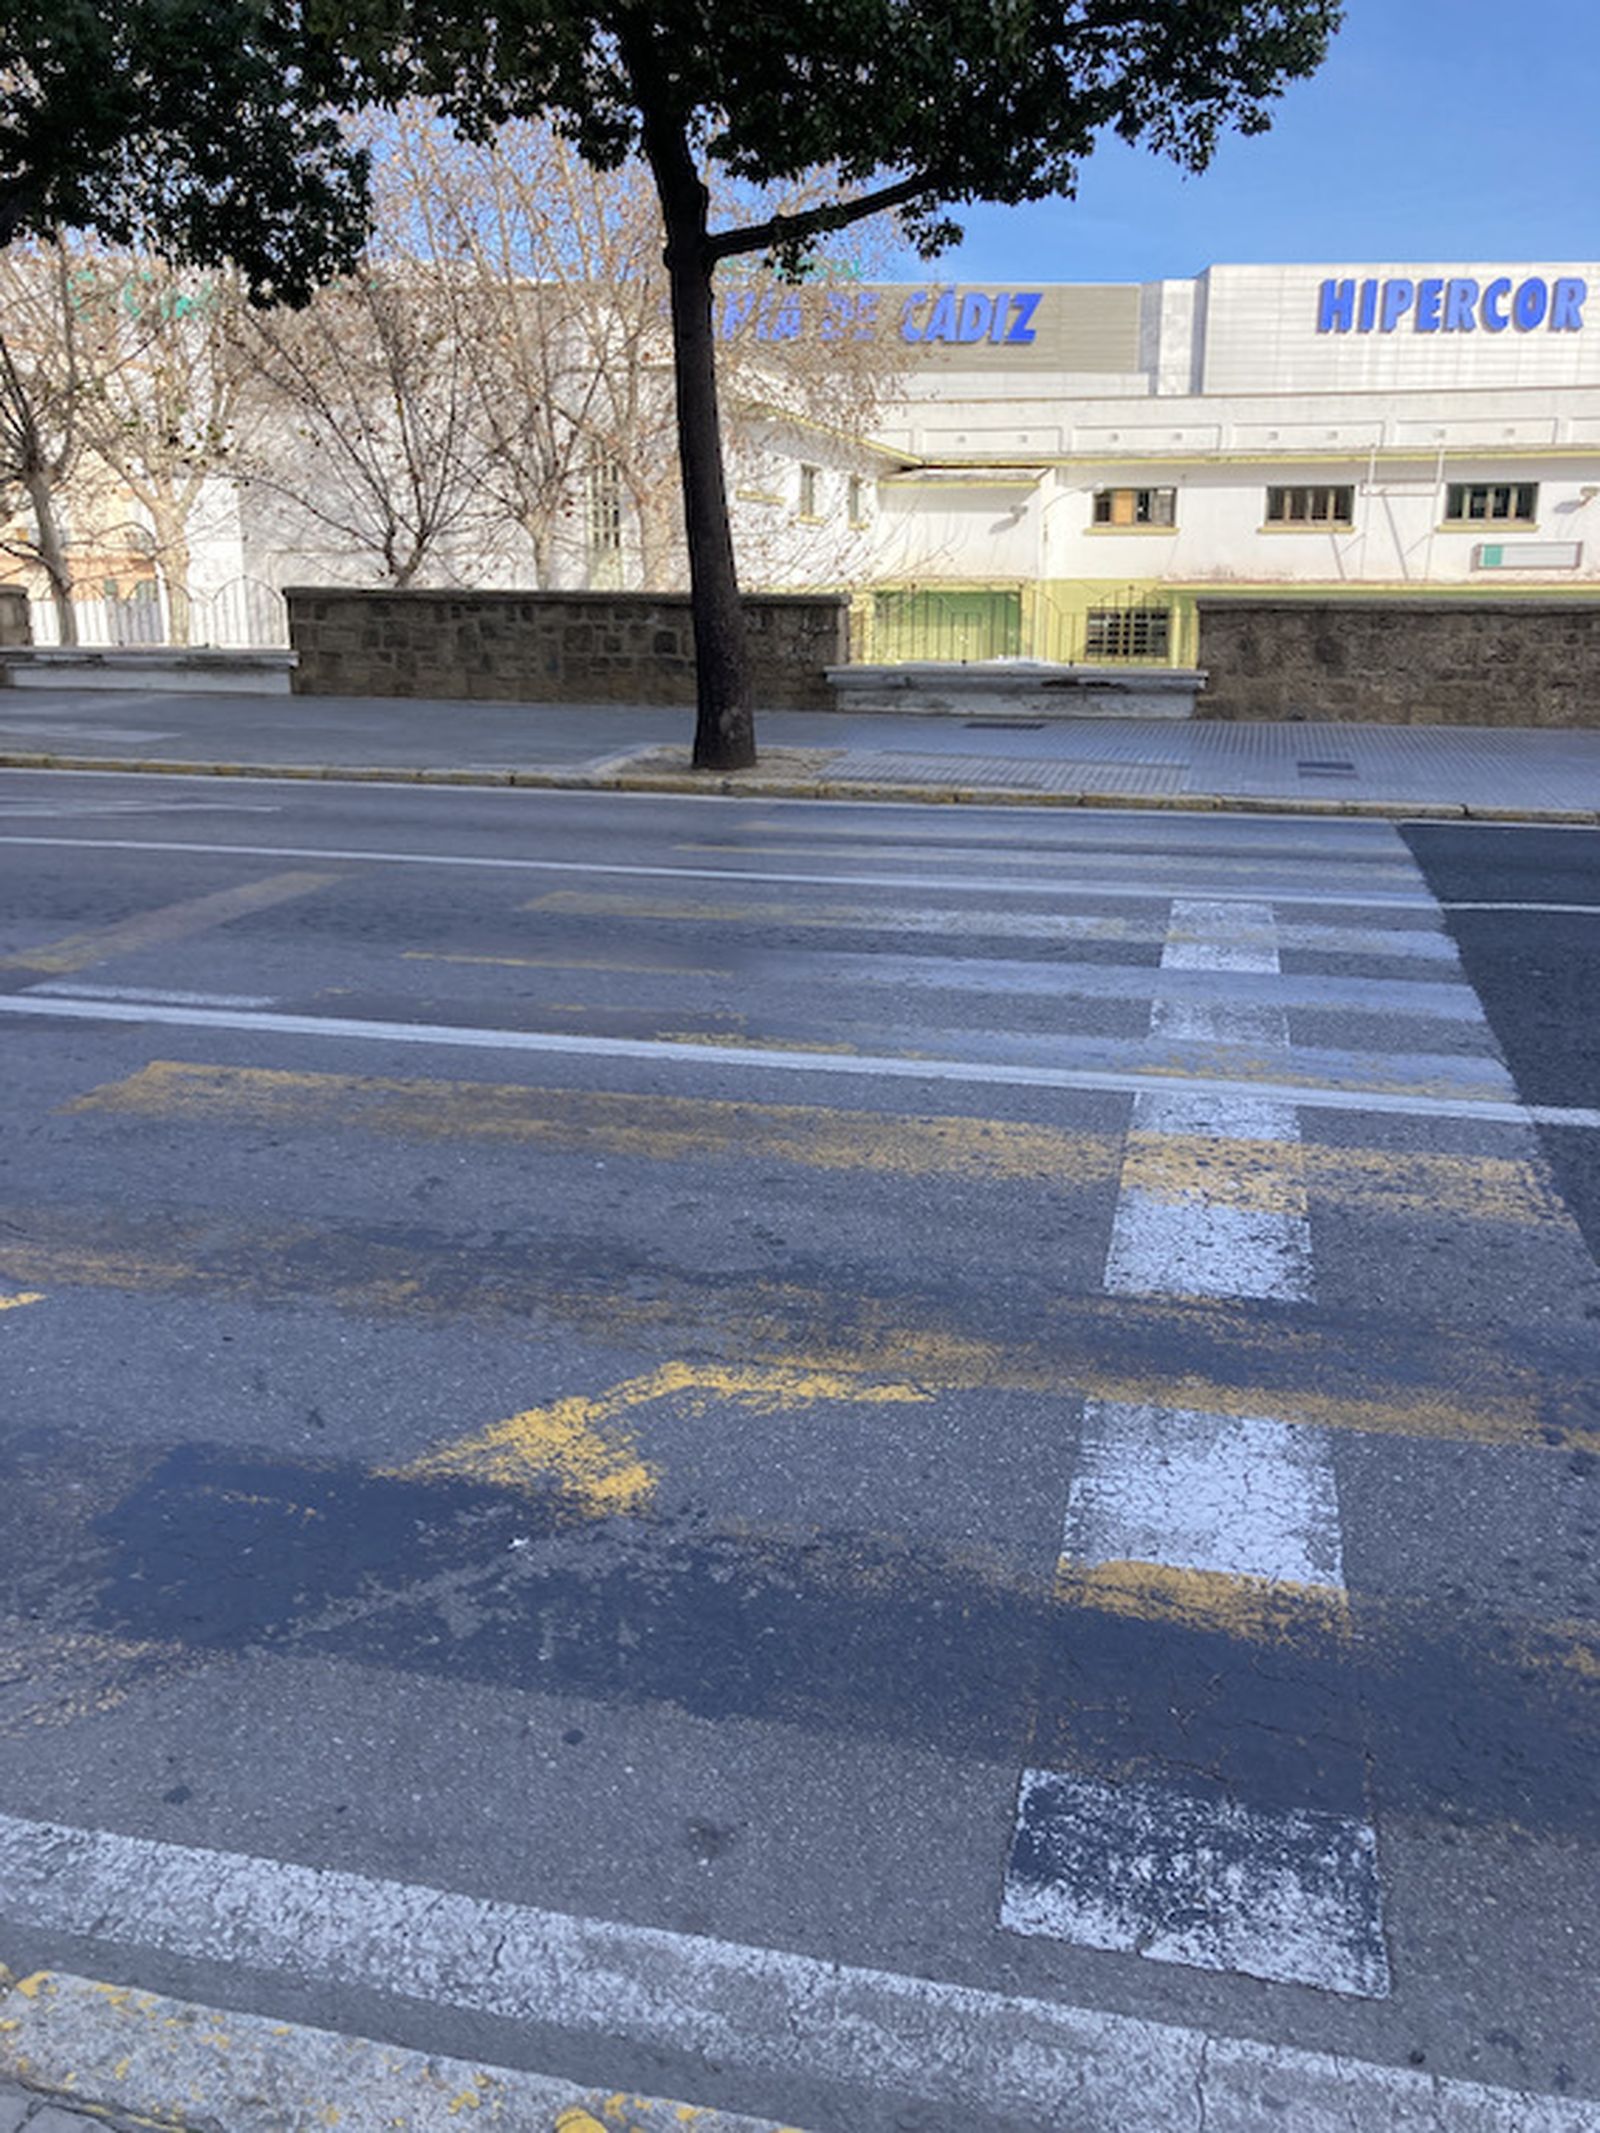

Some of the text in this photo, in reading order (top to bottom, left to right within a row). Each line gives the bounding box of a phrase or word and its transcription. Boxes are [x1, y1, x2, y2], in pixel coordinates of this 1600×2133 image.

[820, 291, 881, 342] DE
[899, 285, 1042, 345] CÁDIZ
[1316, 277, 1587, 334] HIPERCOR
